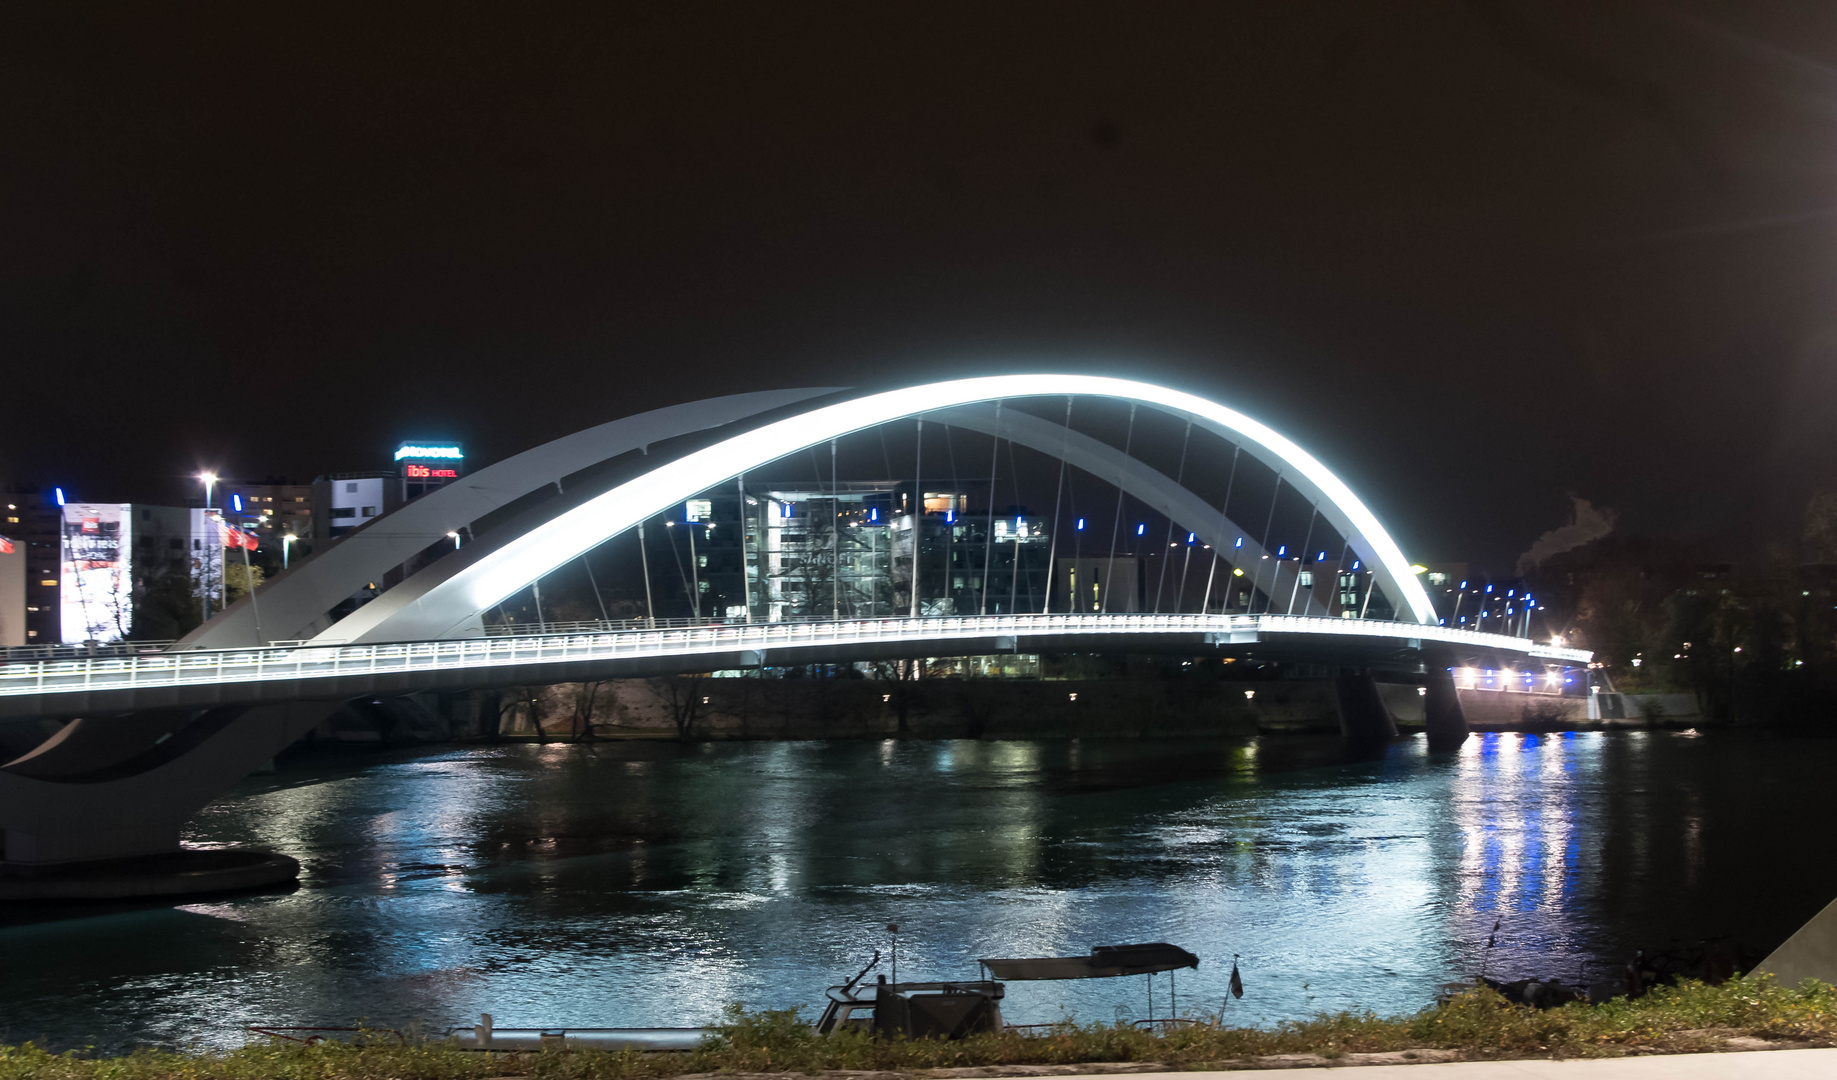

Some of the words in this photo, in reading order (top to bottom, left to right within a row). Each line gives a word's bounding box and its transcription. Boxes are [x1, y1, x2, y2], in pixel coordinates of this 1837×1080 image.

[401, 446, 464, 458] NOVOTEL
[407, 465, 430, 477] ibis
[431, 469, 457, 477] HOTEL
